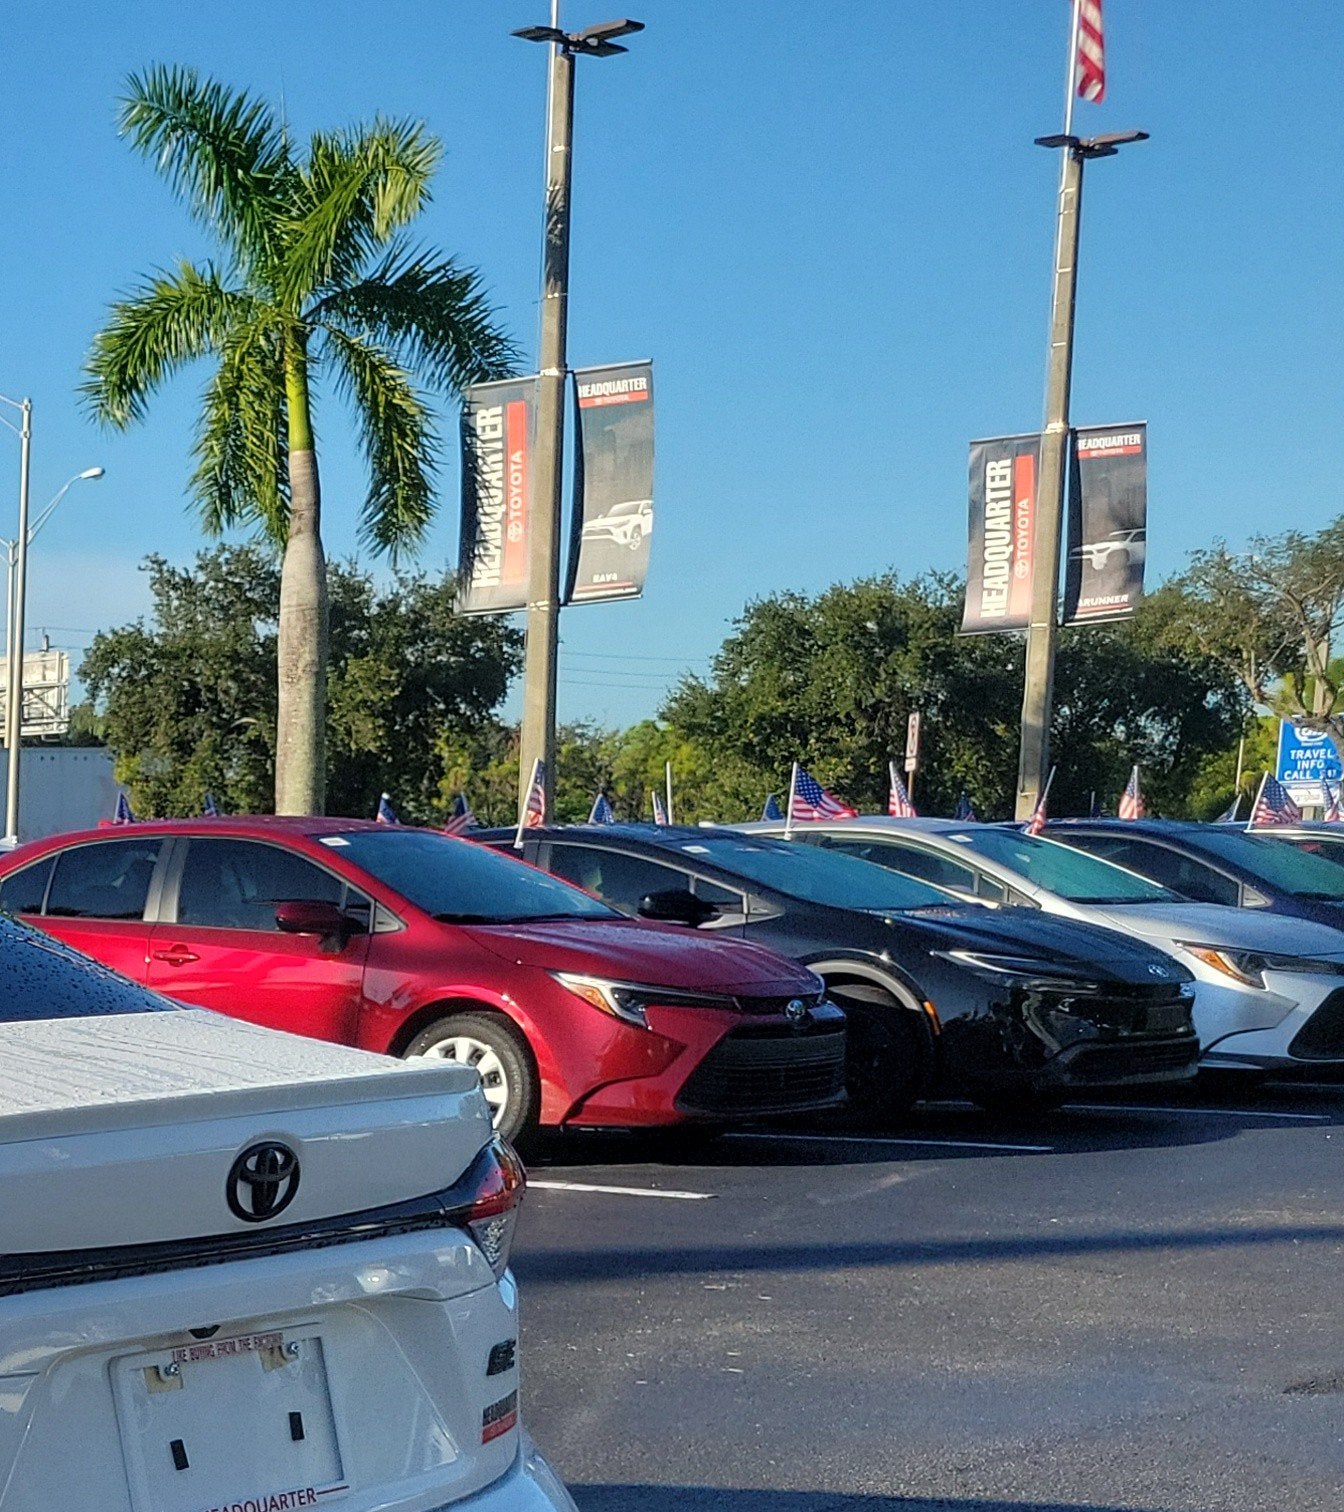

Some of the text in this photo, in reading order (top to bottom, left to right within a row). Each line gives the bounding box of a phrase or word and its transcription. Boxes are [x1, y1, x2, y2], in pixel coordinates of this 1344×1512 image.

[577, 377, 647, 398] HEADQUARTER
[508, 450, 524, 521] TOYOTA
[980, 459, 1014, 617] HEADQUARTER
[1016, 498, 1029, 559] TOYOTA
[1290, 748, 1335, 760] TRAVEL
[1284, 770, 1313, 780] CALL
[1297, 760, 1325, 770] INFO
